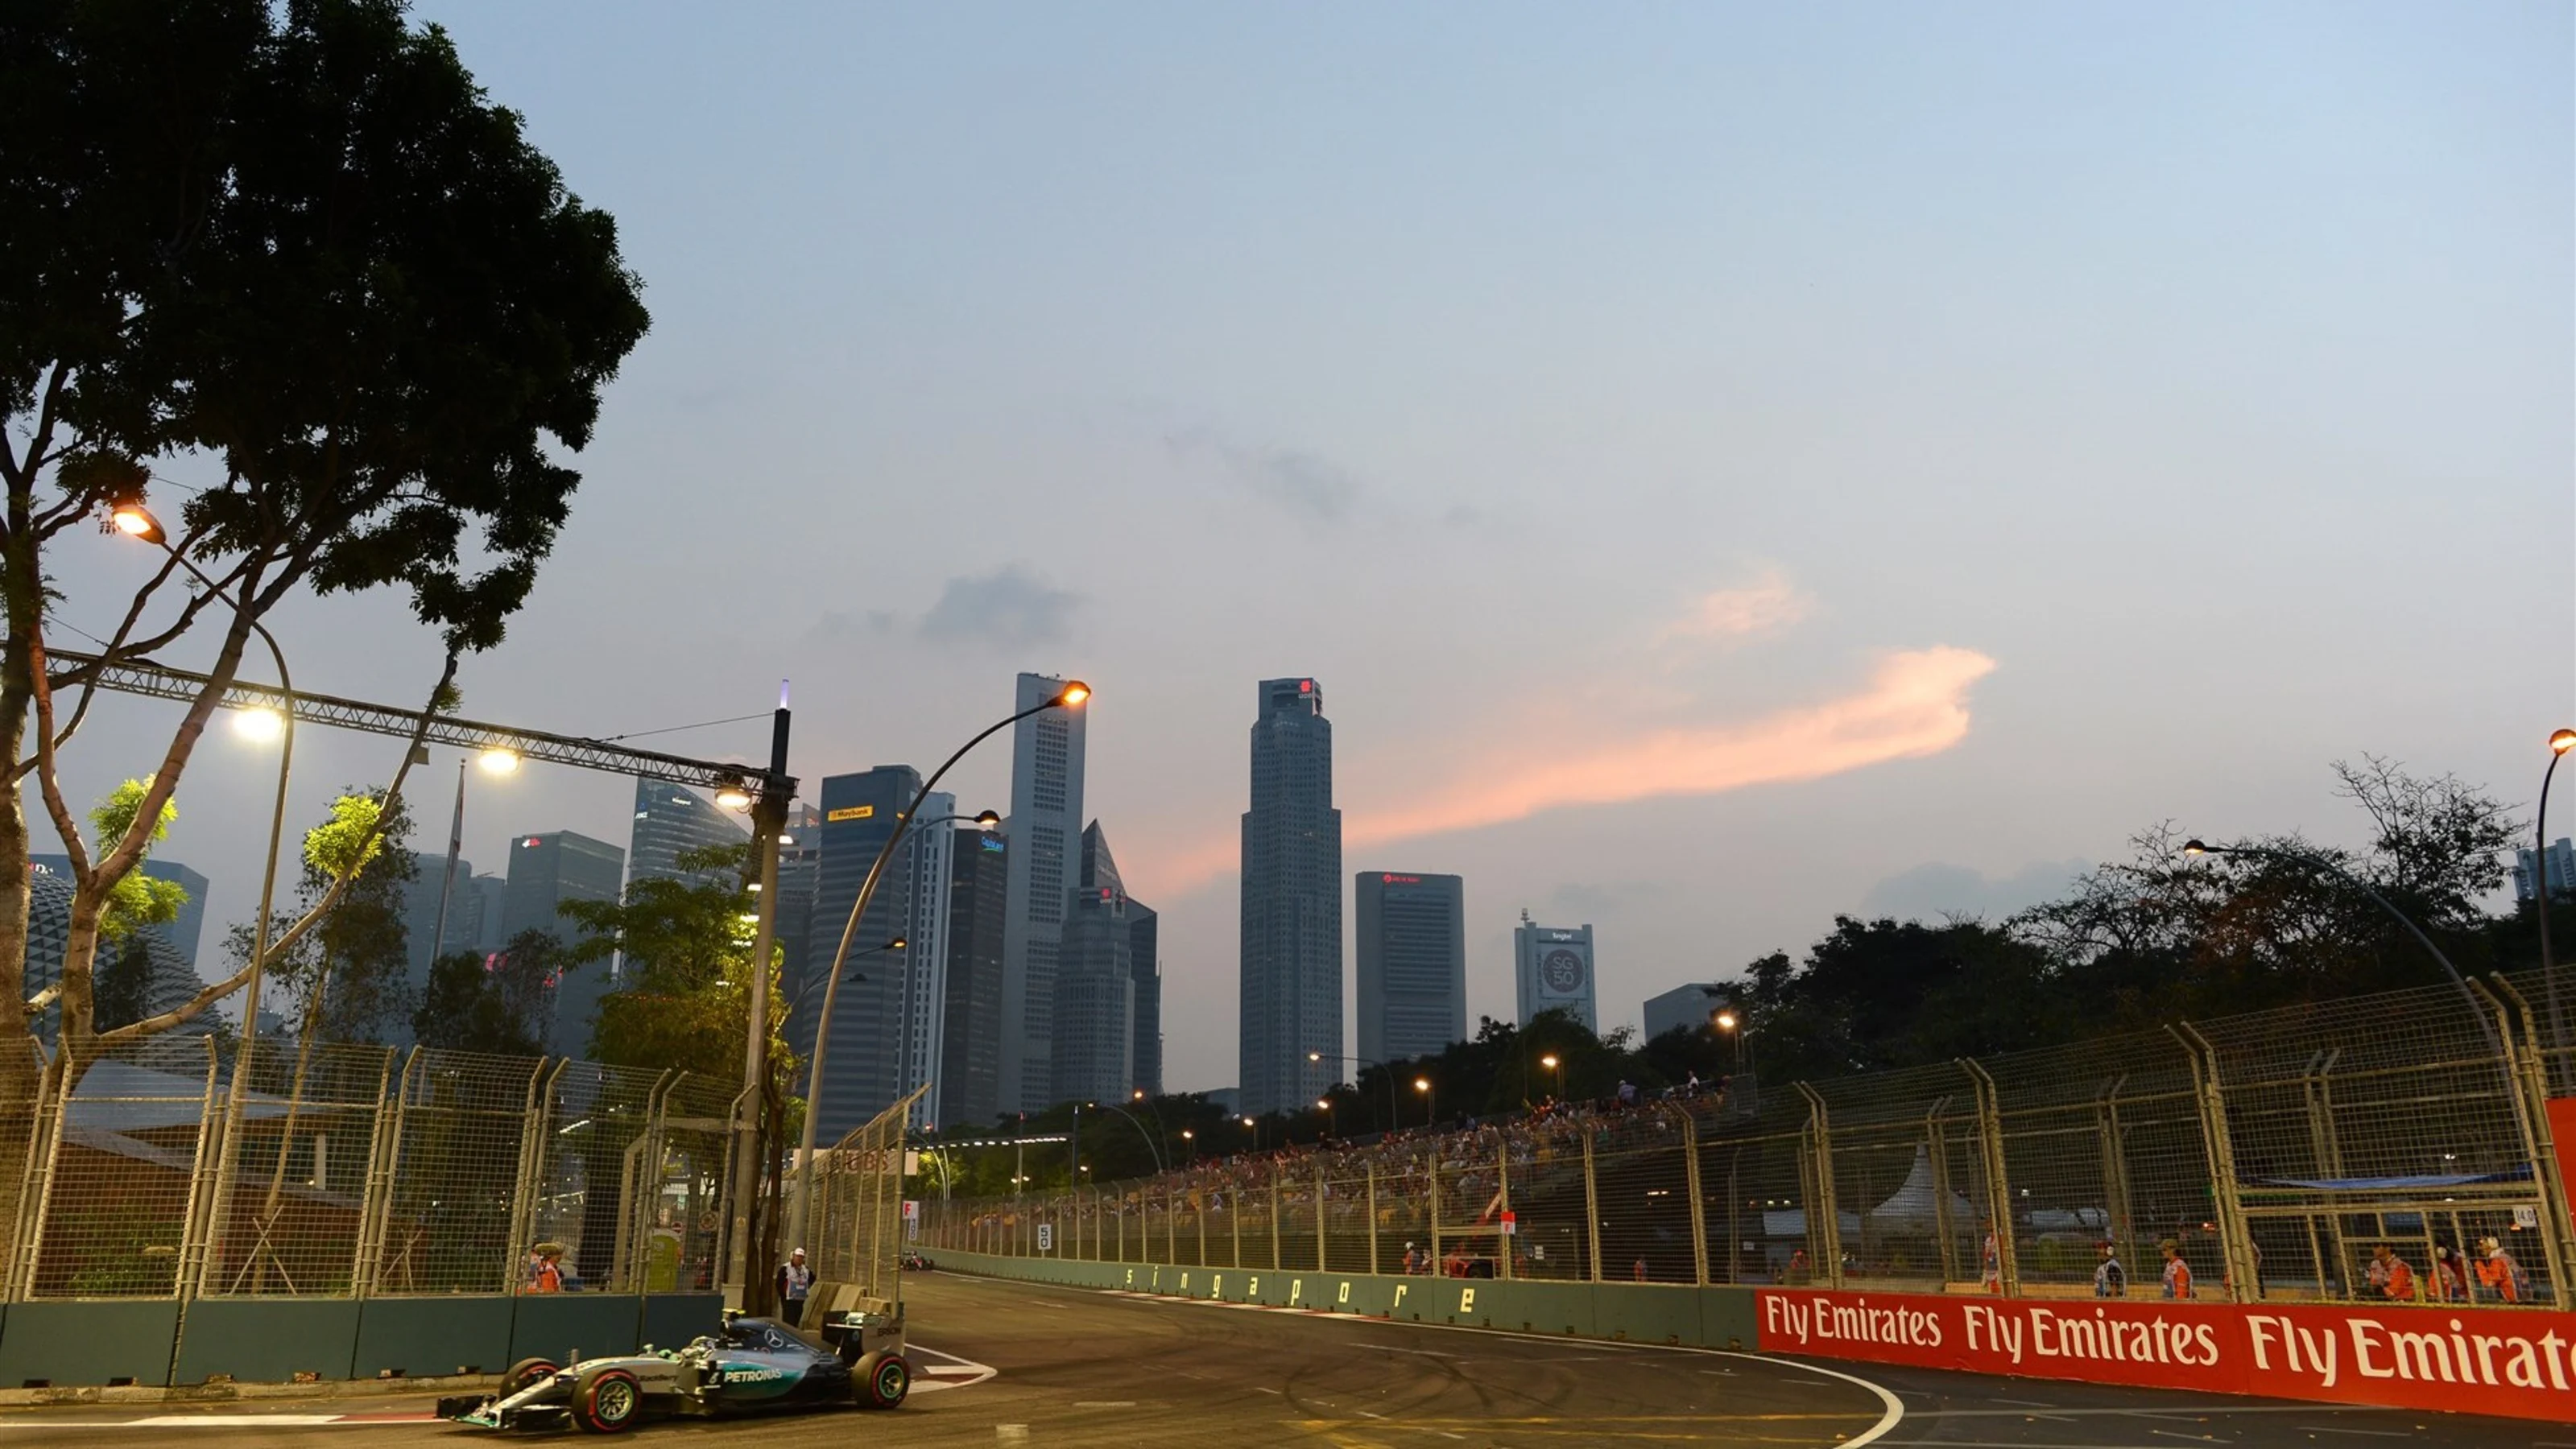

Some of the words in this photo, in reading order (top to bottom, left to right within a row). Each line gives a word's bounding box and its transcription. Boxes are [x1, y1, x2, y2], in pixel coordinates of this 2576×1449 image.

[1553, 956, 1575, 970] SG
[1553, 970, 1574, 985] 50
[1040, 1226, 1048, 1248] 50
[1127, 1265, 1475, 1313] singapore
[1765, 1295, 1808, 1344] Fly
[1813, 1298, 1942, 1347] Emirates
[1962, 1305, 2022, 1364] Fly
[2029, 1307, 2218, 1366] Emirates
[2245, 1315, 2335, 1387] Fly
[724, 1369, 782, 1383] PETRONAS
